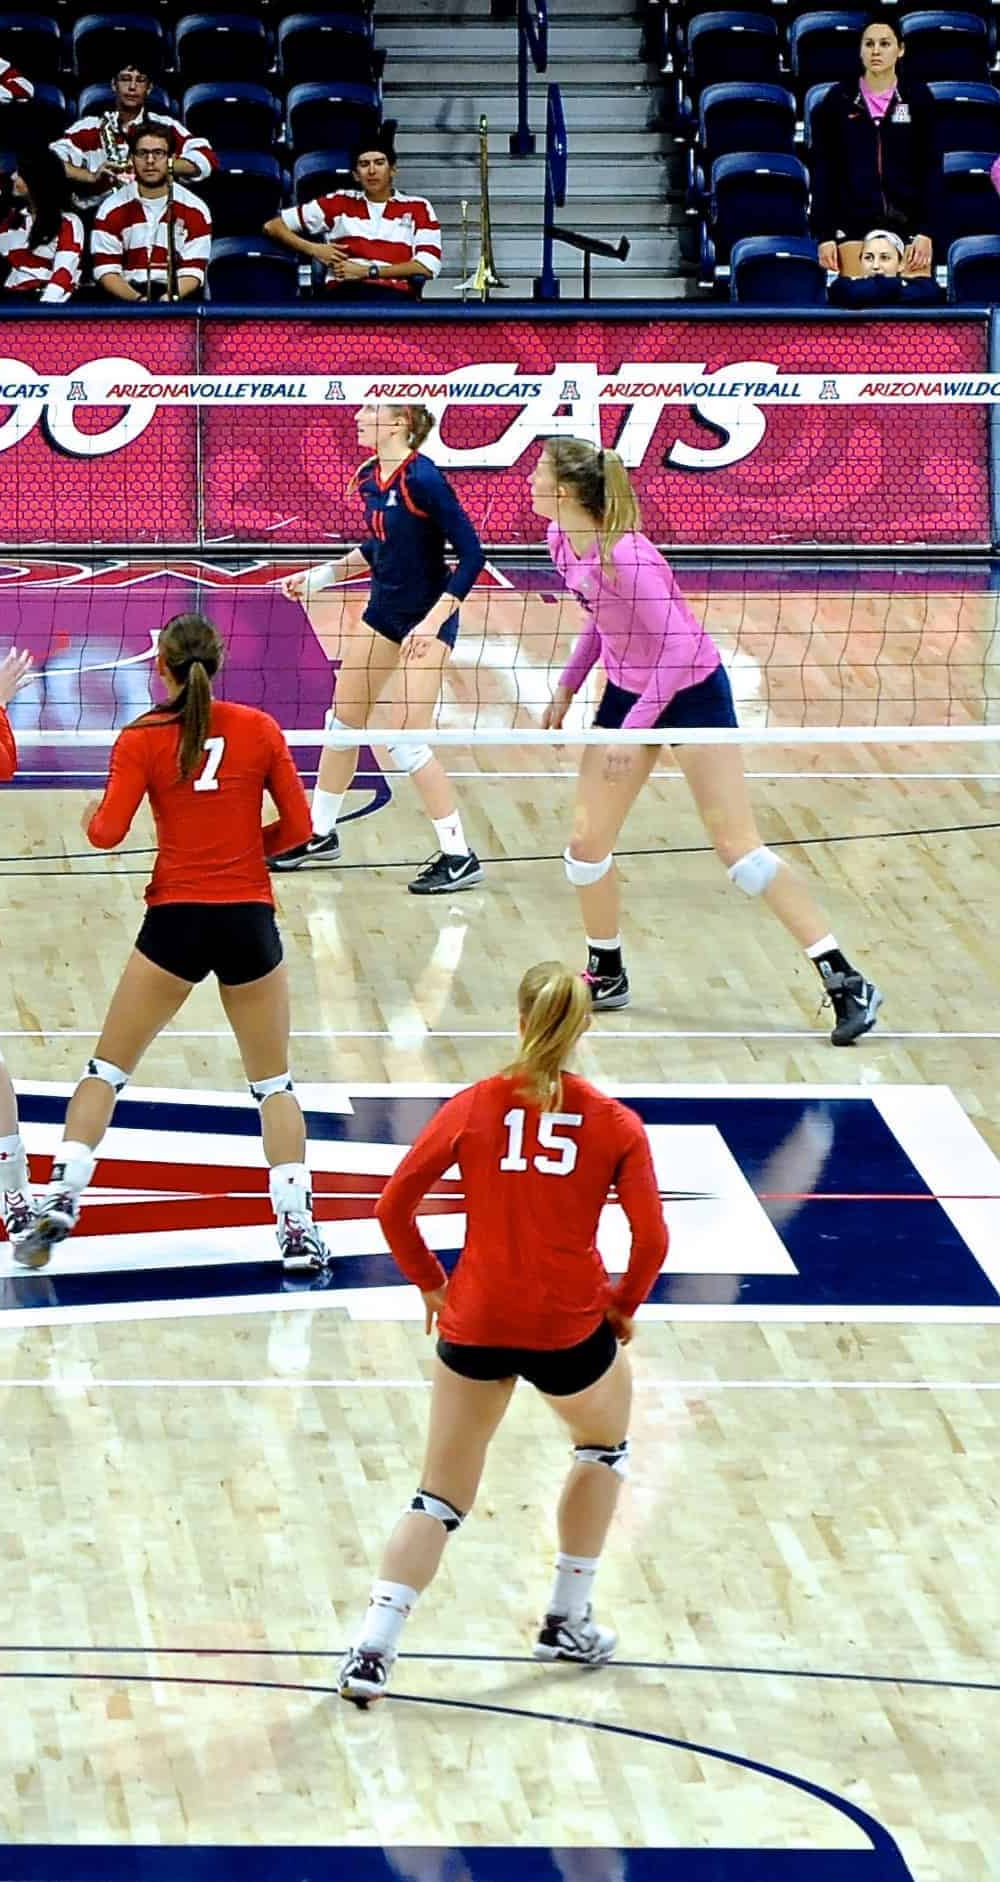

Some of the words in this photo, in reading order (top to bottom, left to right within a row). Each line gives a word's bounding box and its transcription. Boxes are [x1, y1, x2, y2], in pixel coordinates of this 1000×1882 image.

[106, 383, 307, 398] ARIZONAVOLLEYBALL
[364, 383, 542, 397] ARIZONAWILDCATS
[599, 382, 801, 397] ARIZONAVOLLEYBALL
[500, 1108, 583, 1175] 15
